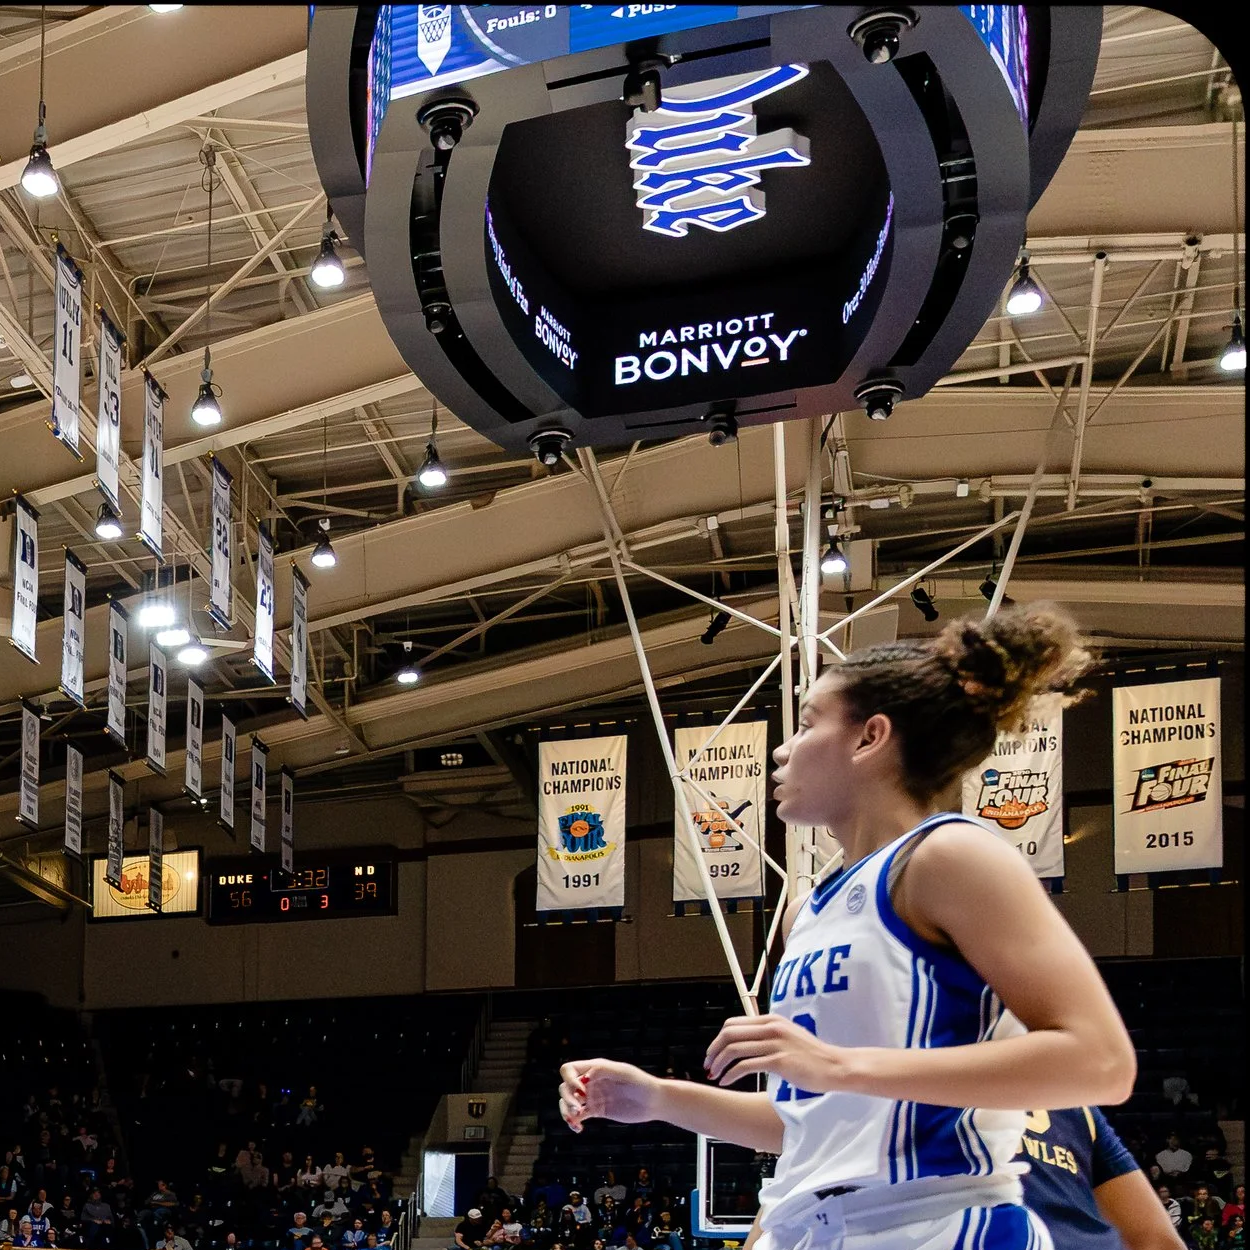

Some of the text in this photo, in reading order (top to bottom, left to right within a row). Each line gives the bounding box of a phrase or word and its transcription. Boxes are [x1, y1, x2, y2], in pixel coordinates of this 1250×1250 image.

[486, 11, 542, 34] Fouls:
[541, 305, 571, 343] MARRIOTT
[638, 313, 775, 348] MARRIOTT
[1129, 703, 1206, 725] NATIONAL
[1120, 722, 1216, 746] CHAMPIONS
[551, 757, 615, 776] NATIONAL
[689, 761, 762, 782] HAMPIONS
[1157, 759, 1212, 783] FINAL
[543, 774, 622, 796] CHAMPIONS
[999, 771, 1048, 789] FINAL
[976, 786, 1048, 809] FOUR
[1135, 775, 1209, 807] FOUR
[570, 803, 590, 812] 1991
[1145, 830, 1194, 849] 2015
[219, 873, 253, 885] DUKE
[709, 862, 740, 878] 992
[355, 882, 377, 900] 39
[562, 873, 601, 889] 1991
[281, 897, 289, 911] 0
[320, 894, 329, 909] 3
[772, 944, 852, 1002] UKE
[1017, 1135, 1078, 1175] WLES
